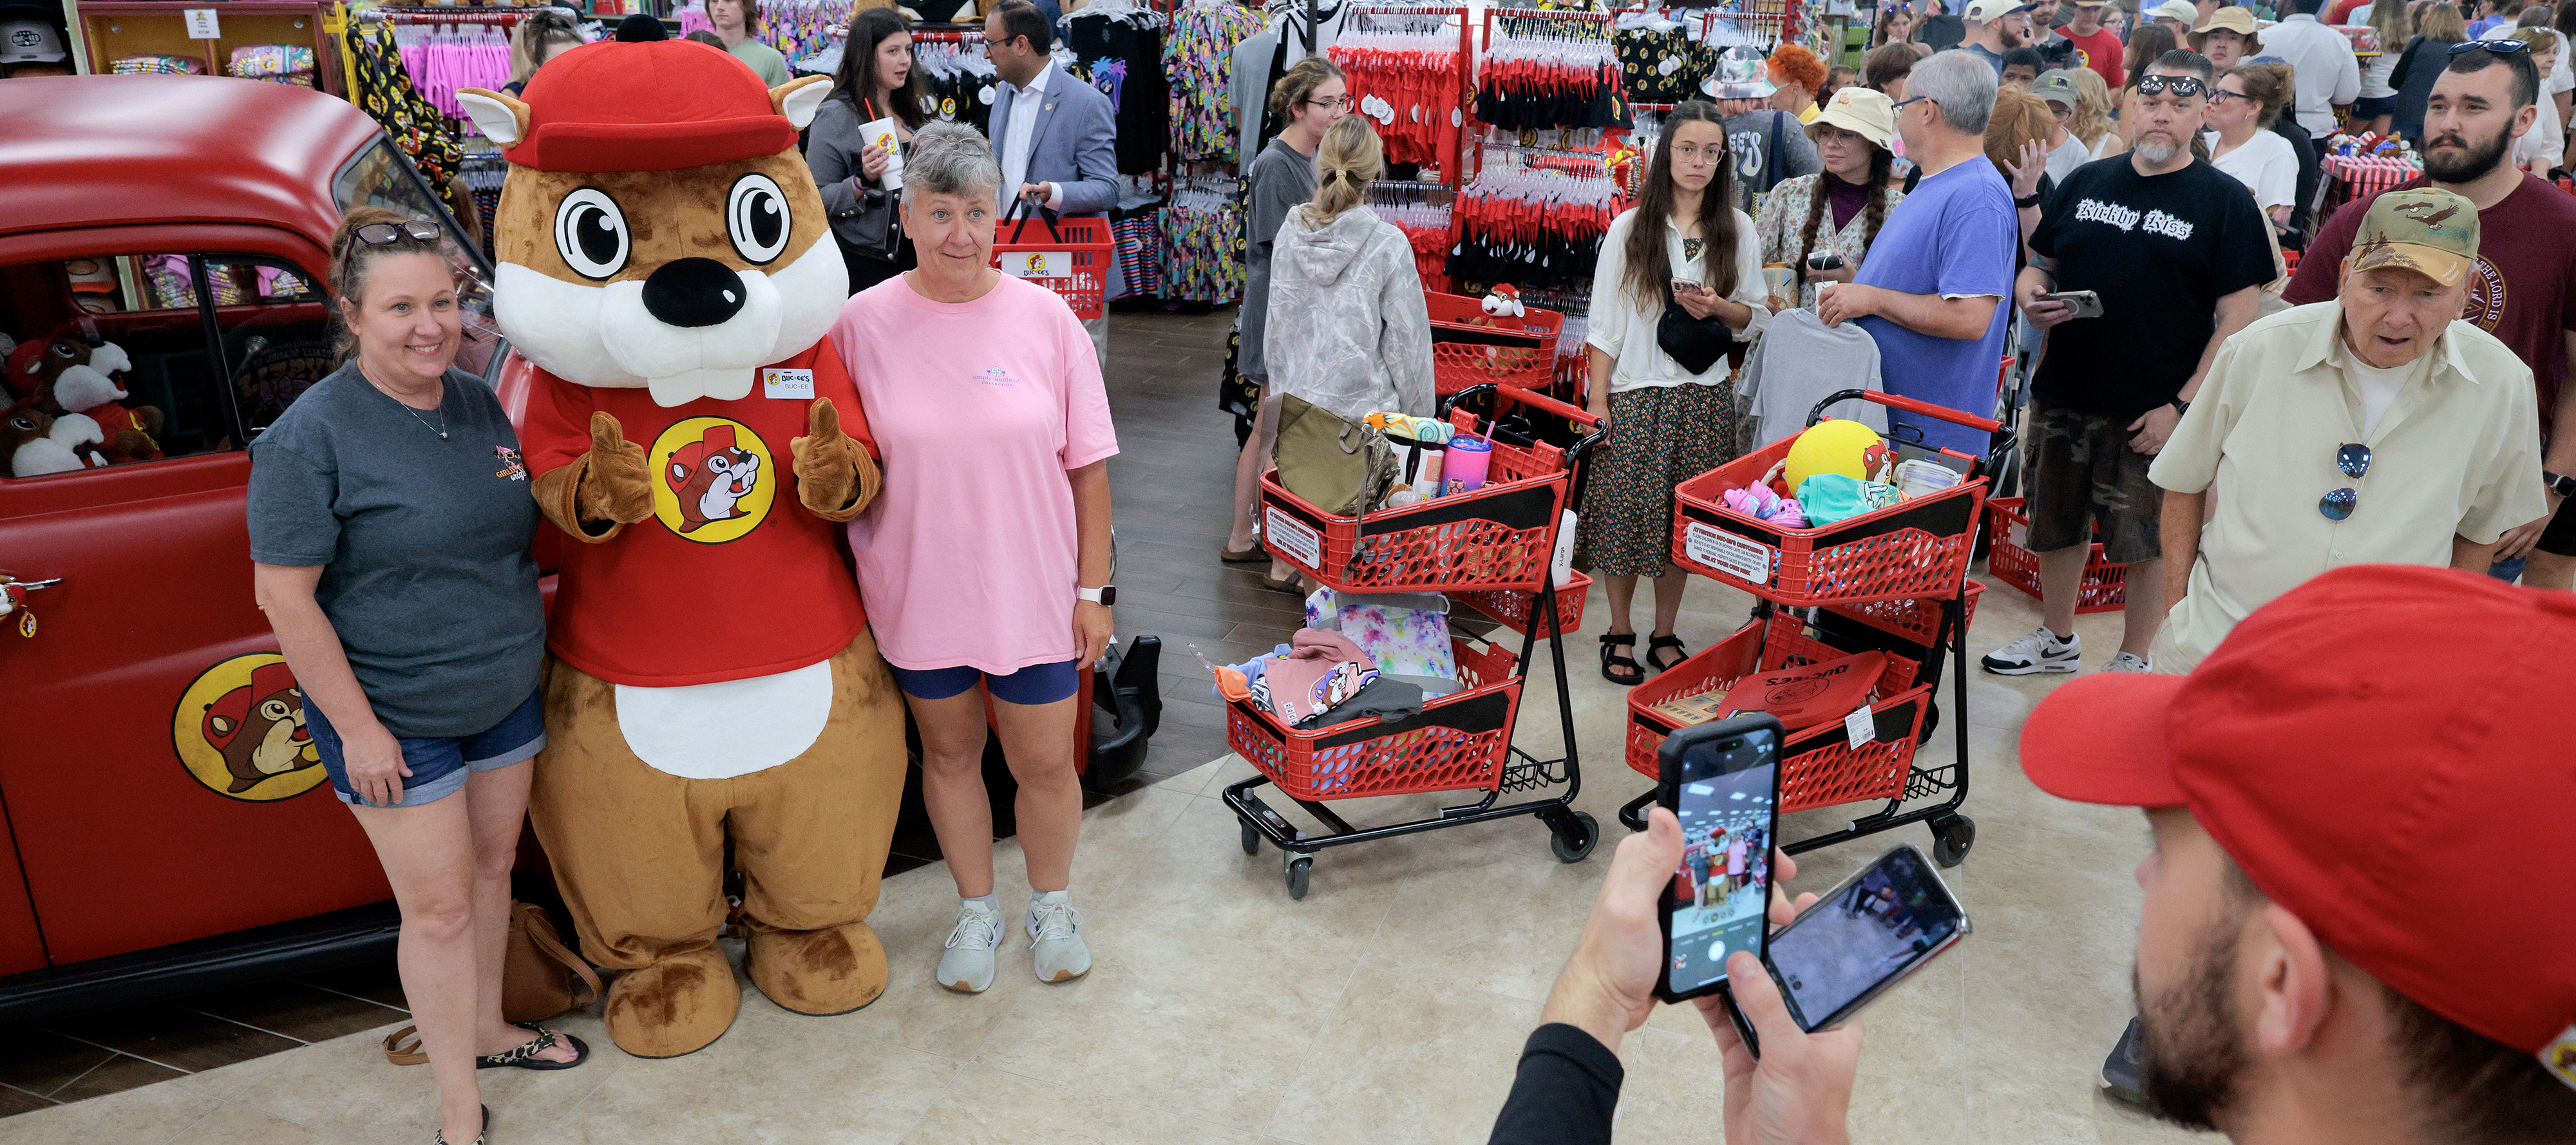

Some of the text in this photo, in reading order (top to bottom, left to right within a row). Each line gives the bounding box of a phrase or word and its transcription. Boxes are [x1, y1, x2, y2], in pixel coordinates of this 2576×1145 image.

[1728, 131, 1763, 176] EE'S
[2479, 260, 2497, 279] THE
[2490, 279, 2503, 307] LORD
[2486, 310, 2499, 320] IS
[1765, 664, 1849, 686] BUC-EE'S
